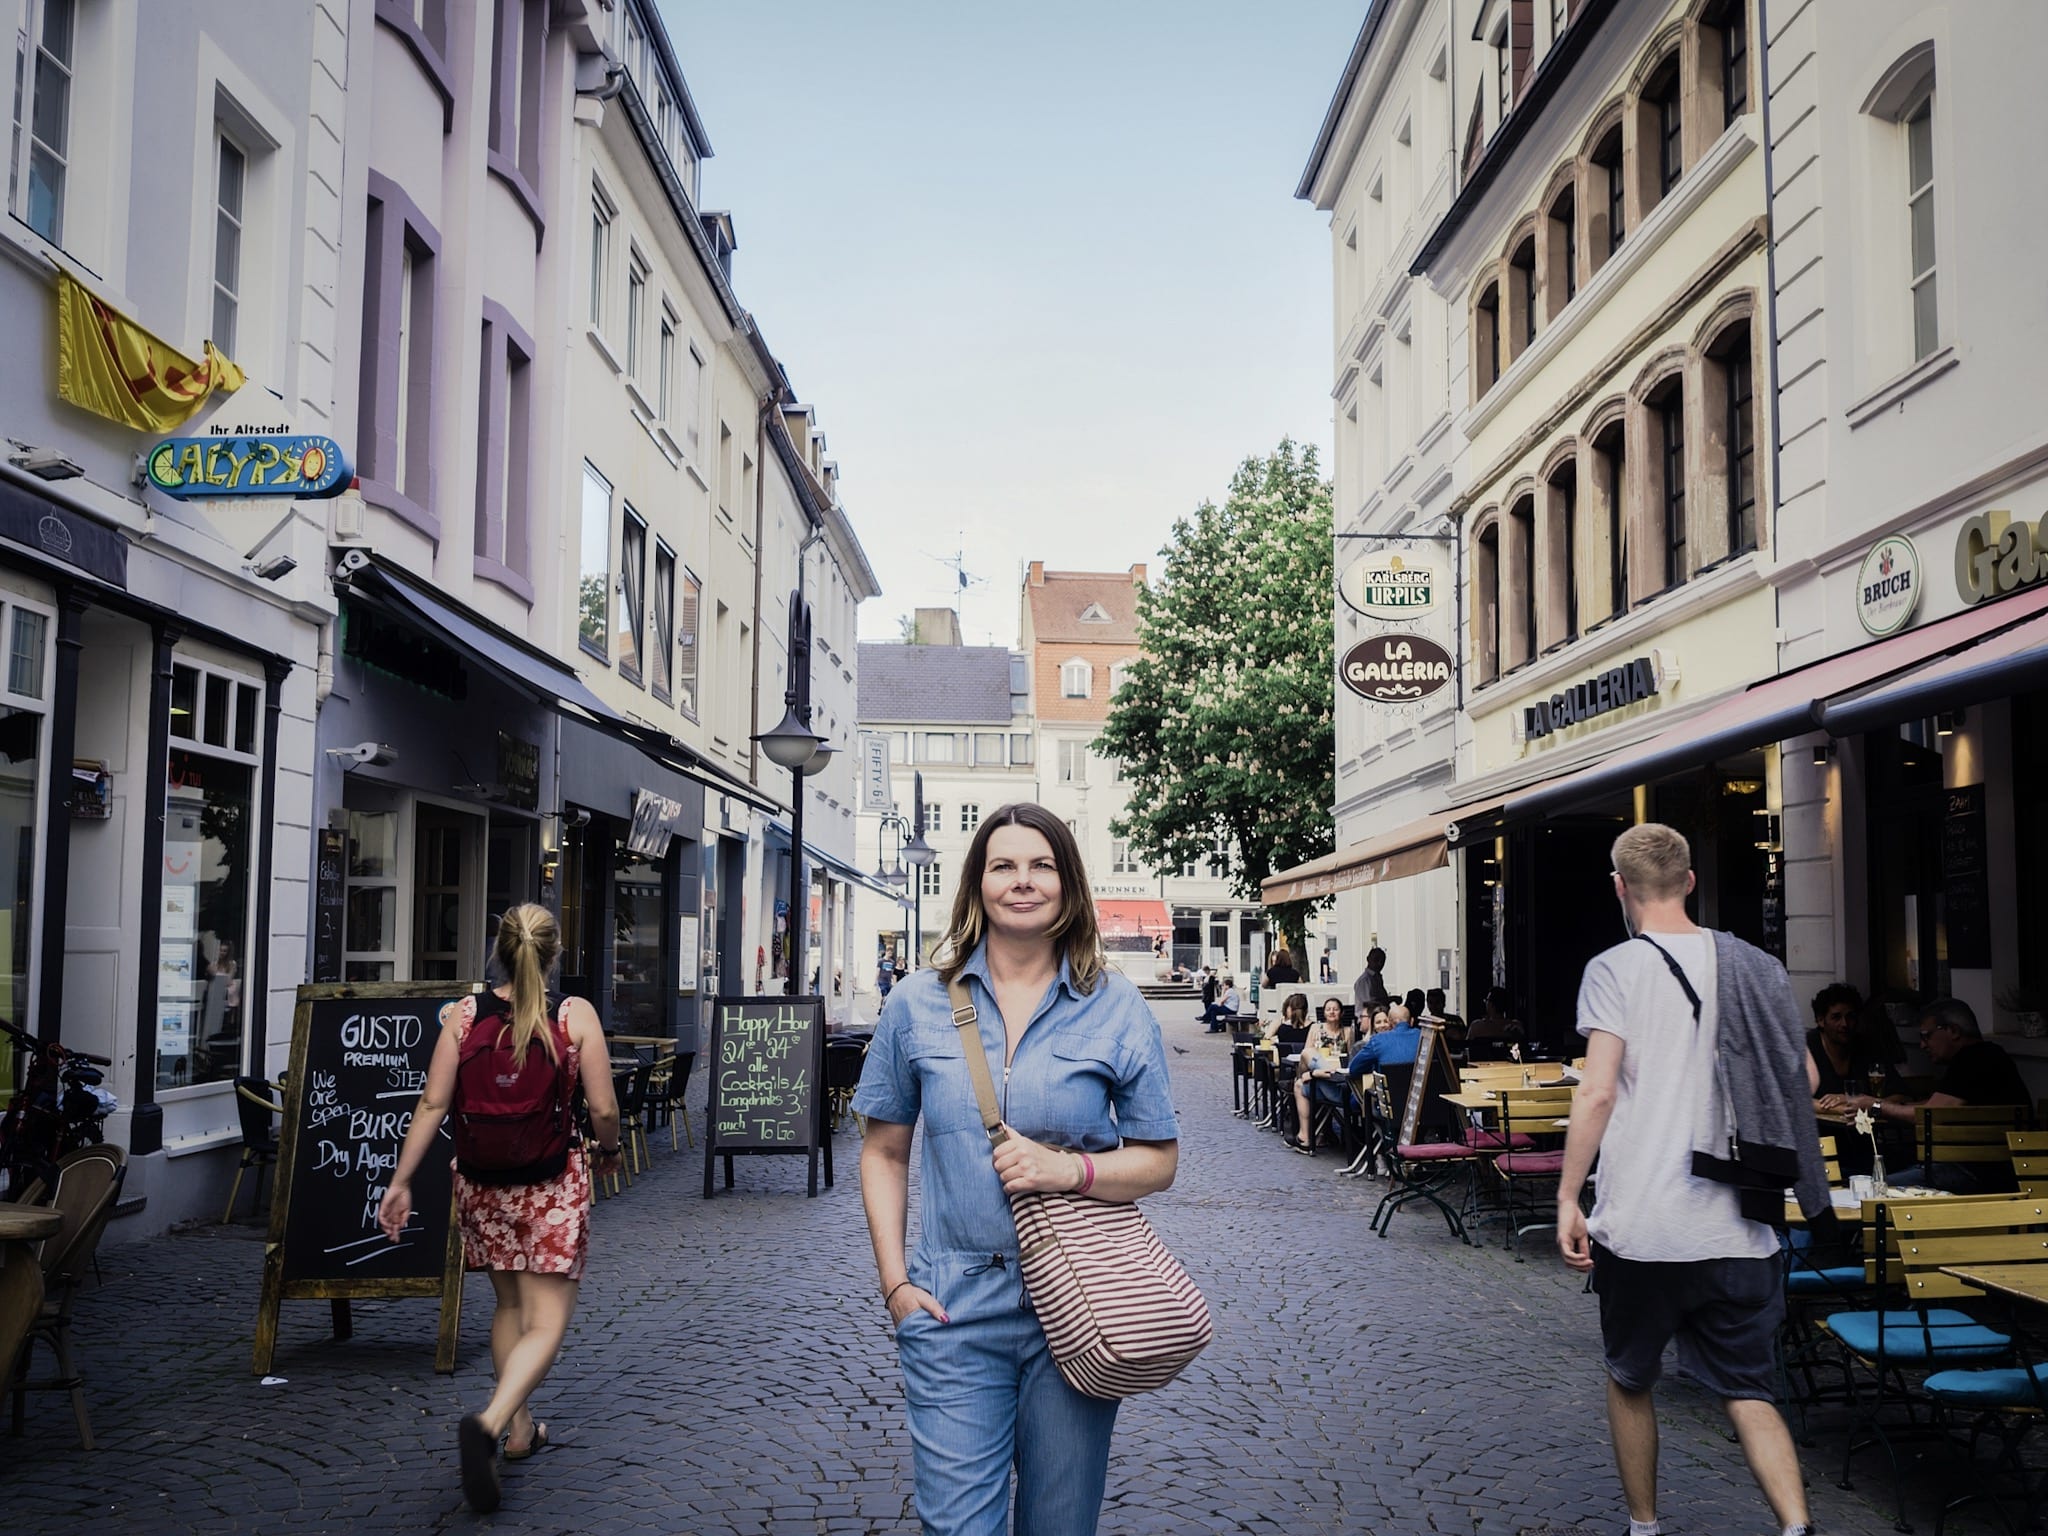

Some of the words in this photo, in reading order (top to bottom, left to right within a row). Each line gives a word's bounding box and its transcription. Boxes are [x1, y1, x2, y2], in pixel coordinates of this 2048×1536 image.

[210, 425, 229, 435] Ihr
[235, 424, 290, 435] Altstadt
[149, 439, 328, 488] CALYPSO
[1955, 510, 2048, 605] Ga
[1366, 571, 1429, 584] KARLSBERG
[1863, 571, 1911, 605] BRUCH
[1384, 641, 1412, 660] LA
[1347, 661, 1449, 681] GALLERIA
[1524, 701, 1552, 740] LA
[1549, 657, 1657, 729] GALLERIA
[341, 1015, 422, 1048] GUSTO
[723, 1006, 776, 1042] Happy
[778, 1006, 812, 1031] Hour
[344, 1052, 410, 1069] PREMIUM
[748, 1056, 769, 1072] alle
[313, 1070, 336, 1090] We
[387, 1068, 428, 1091] STEA
[720, 1067, 790, 1091] Cocktails
[309, 1089, 338, 1106] are
[312, 1103, 351, 1126] open
[350, 1110, 452, 1140] BURG
[719, 1113, 746, 1131] auch
[752, 1119, 774, 1140] To
[777, 1121, 796, 1140] Go
[312, 1140, 350, 1178] Dry
[356, 1142, 398, 1181] Aged
[367, 1184, 391, 1200] un
